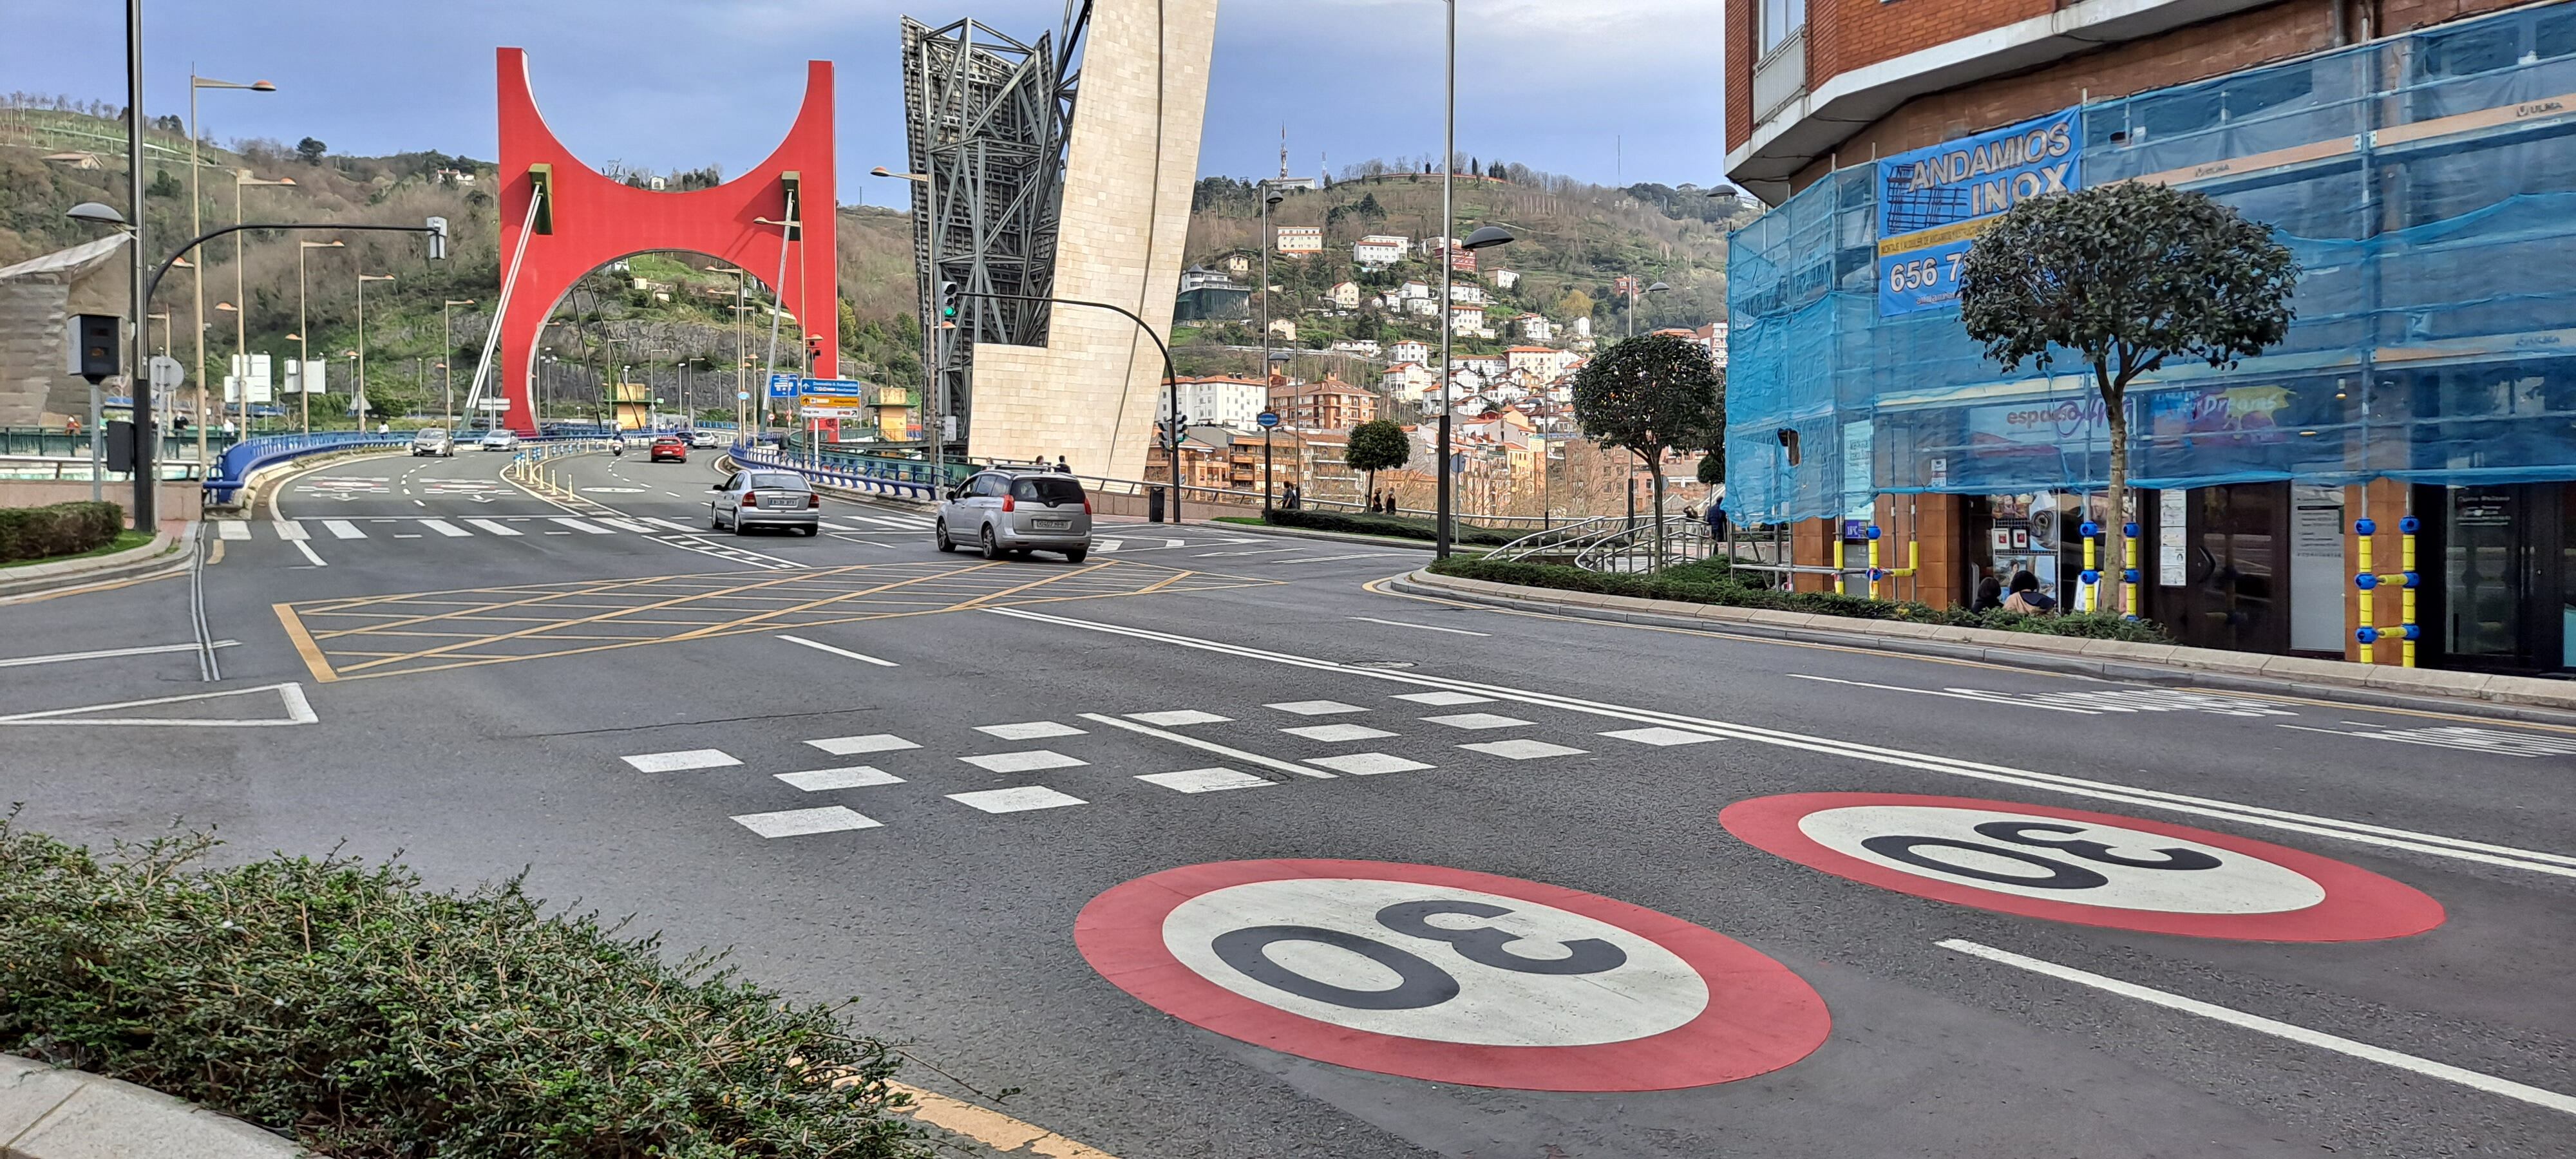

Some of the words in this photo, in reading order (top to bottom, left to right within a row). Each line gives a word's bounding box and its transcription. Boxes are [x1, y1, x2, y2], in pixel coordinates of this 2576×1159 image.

[1908, 122, 2072, 193] ANDAMIOS
[1971, 161, 2070, 217] INOX
[1890, 257, 1938, 292] 656
[1861, 821, 2222, 889] 30
[1211, 900, 1627, 1010] 30
